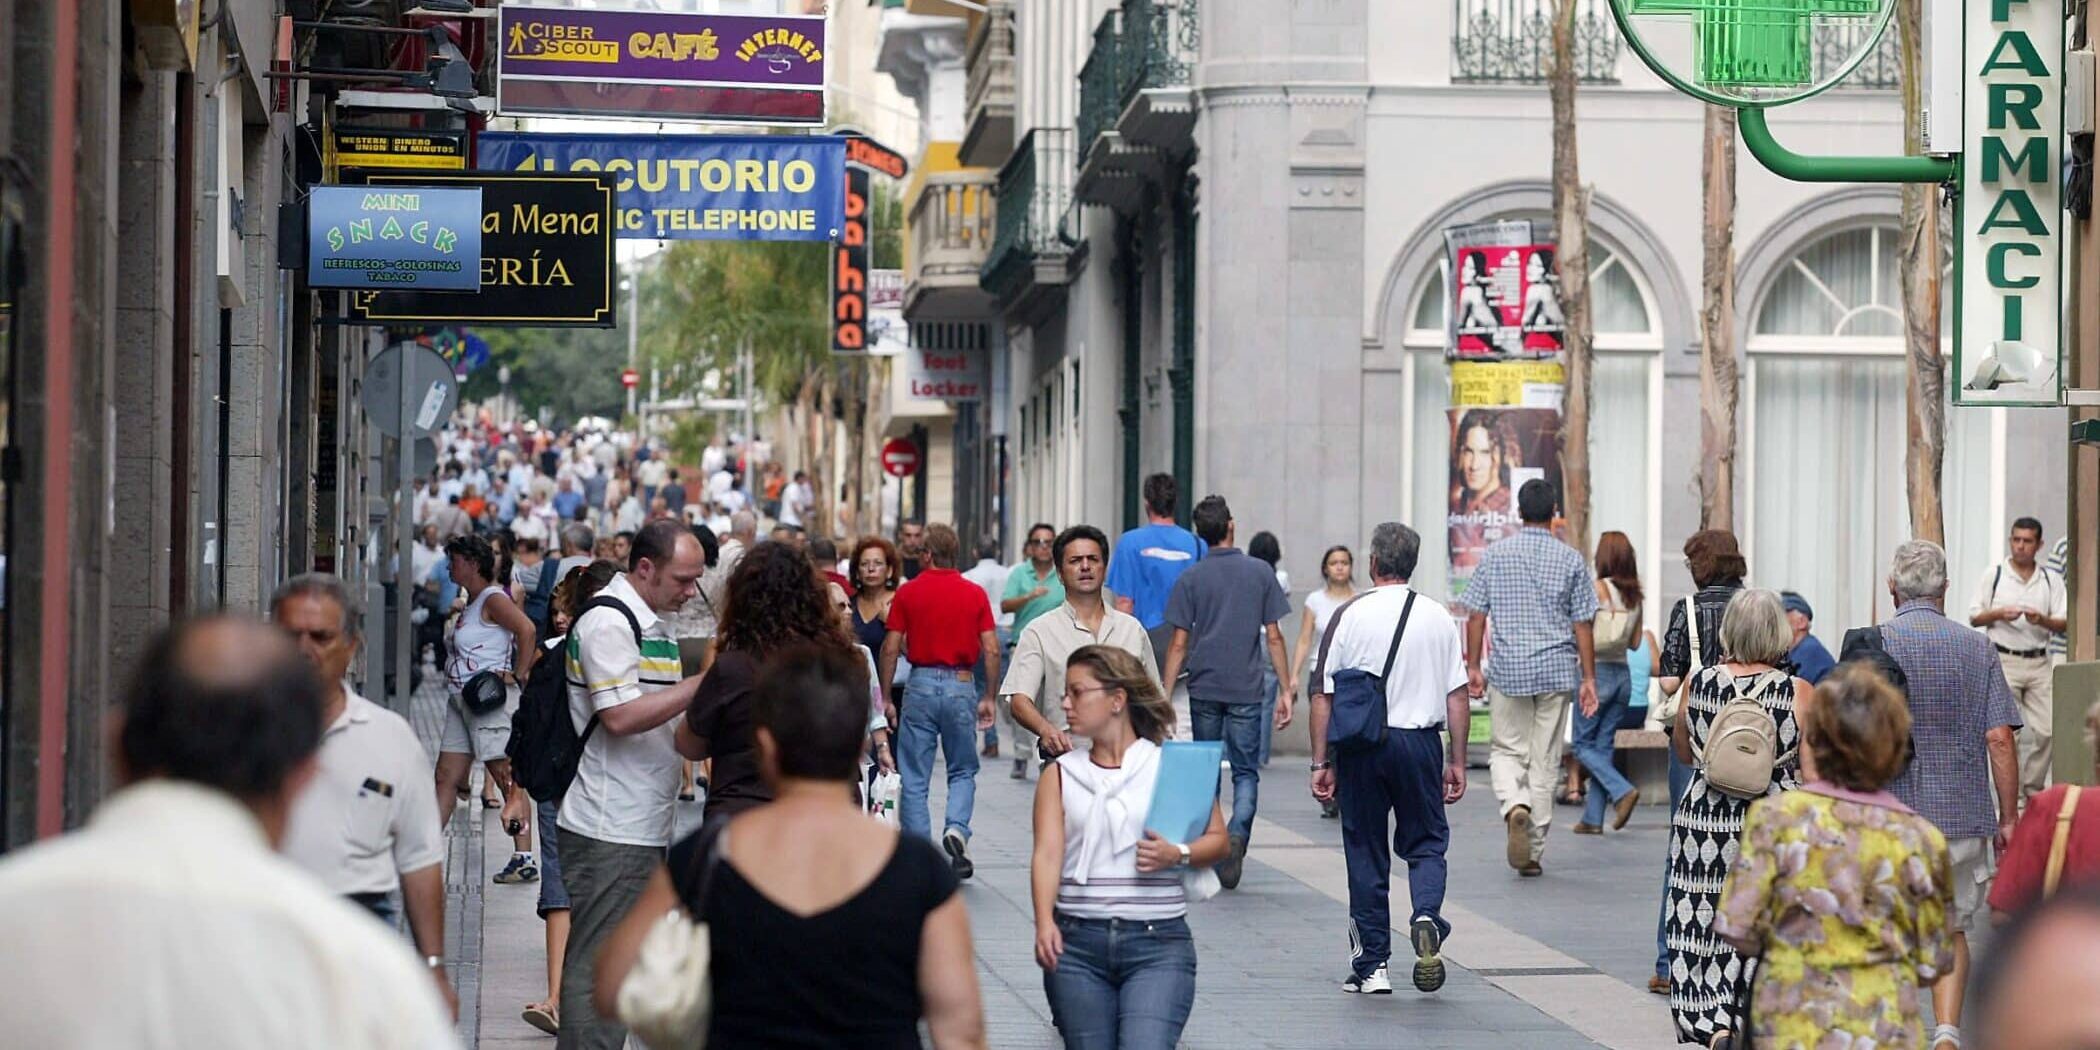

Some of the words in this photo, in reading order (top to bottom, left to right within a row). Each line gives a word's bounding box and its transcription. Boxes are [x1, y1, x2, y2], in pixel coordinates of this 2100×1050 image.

[528, 22, 594, 39] CIBER
[546, 41, 615, 57] SCOUT
[628, 28, 719, 62] CAFÉ
[735, 28, 822, 63] INTERNET
[341, 136, 387, 145] WESTERN
[355, 144, 387, 152] UNION
[394, 138, 431, 146] DINERO
[410, 145, 455, 153] MINUTOS
[361, 194, 420, 211] MINI
[512, 203, 599, 235] Mena
[652, 209, 816, 231] TELEPHONE
[327, 216, 457, 254] SNACK
[367, 271, 417, 283] TABACO
[924, 351, 967, 370] Foot
[912, 379, 977, 397] Locker
